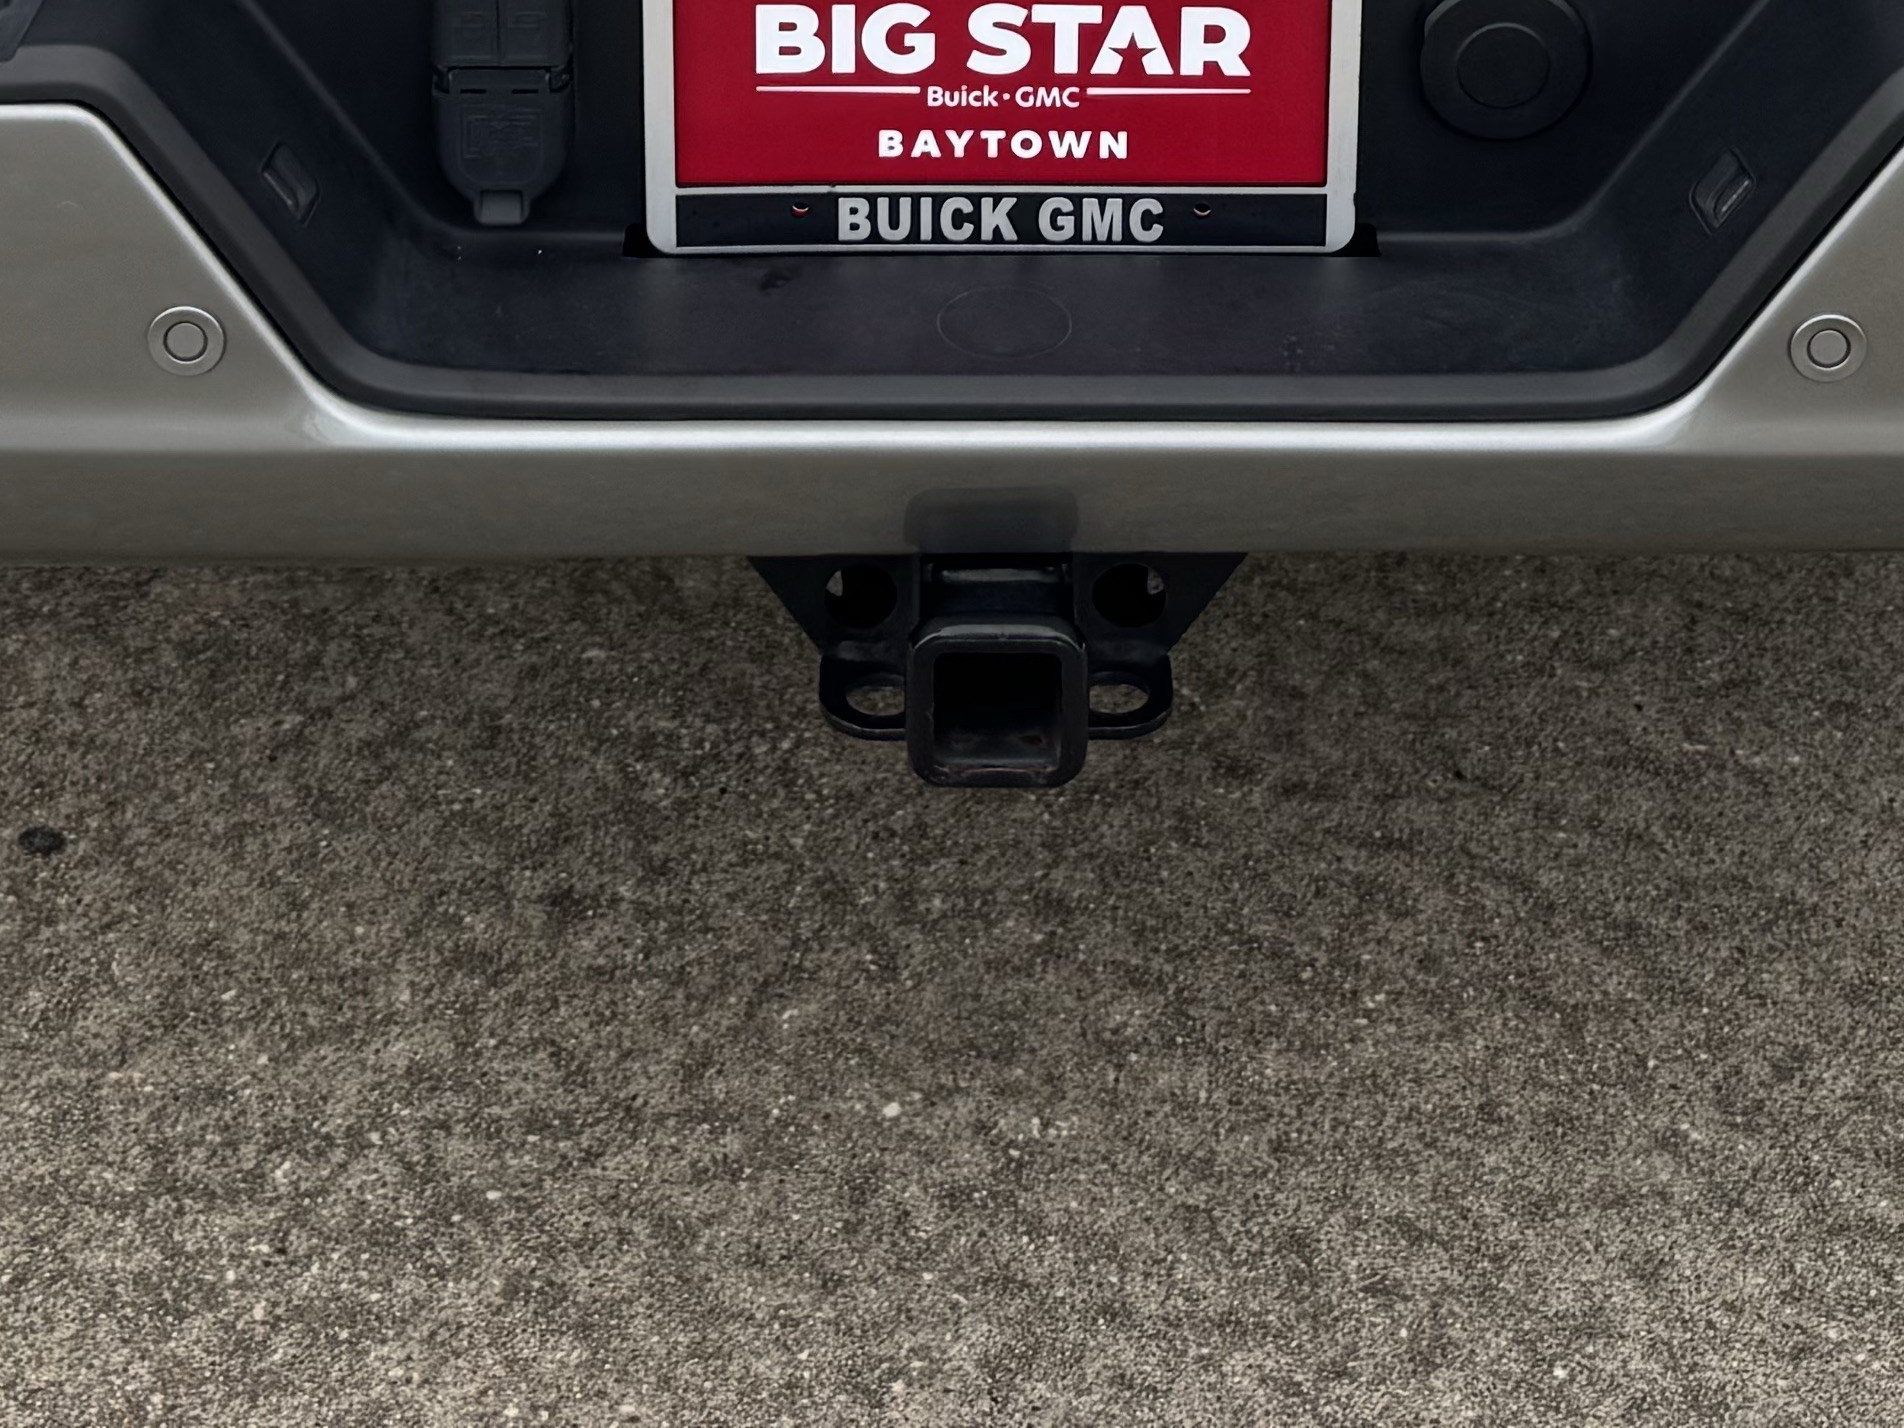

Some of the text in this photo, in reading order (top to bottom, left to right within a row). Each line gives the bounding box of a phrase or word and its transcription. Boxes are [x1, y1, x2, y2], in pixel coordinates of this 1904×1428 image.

[754, 1, 1252, 78] BIG STAR
[877, 128, 1129, 160] BAYTOWN
[836, 195, 1166, 243] BUICK GMC
